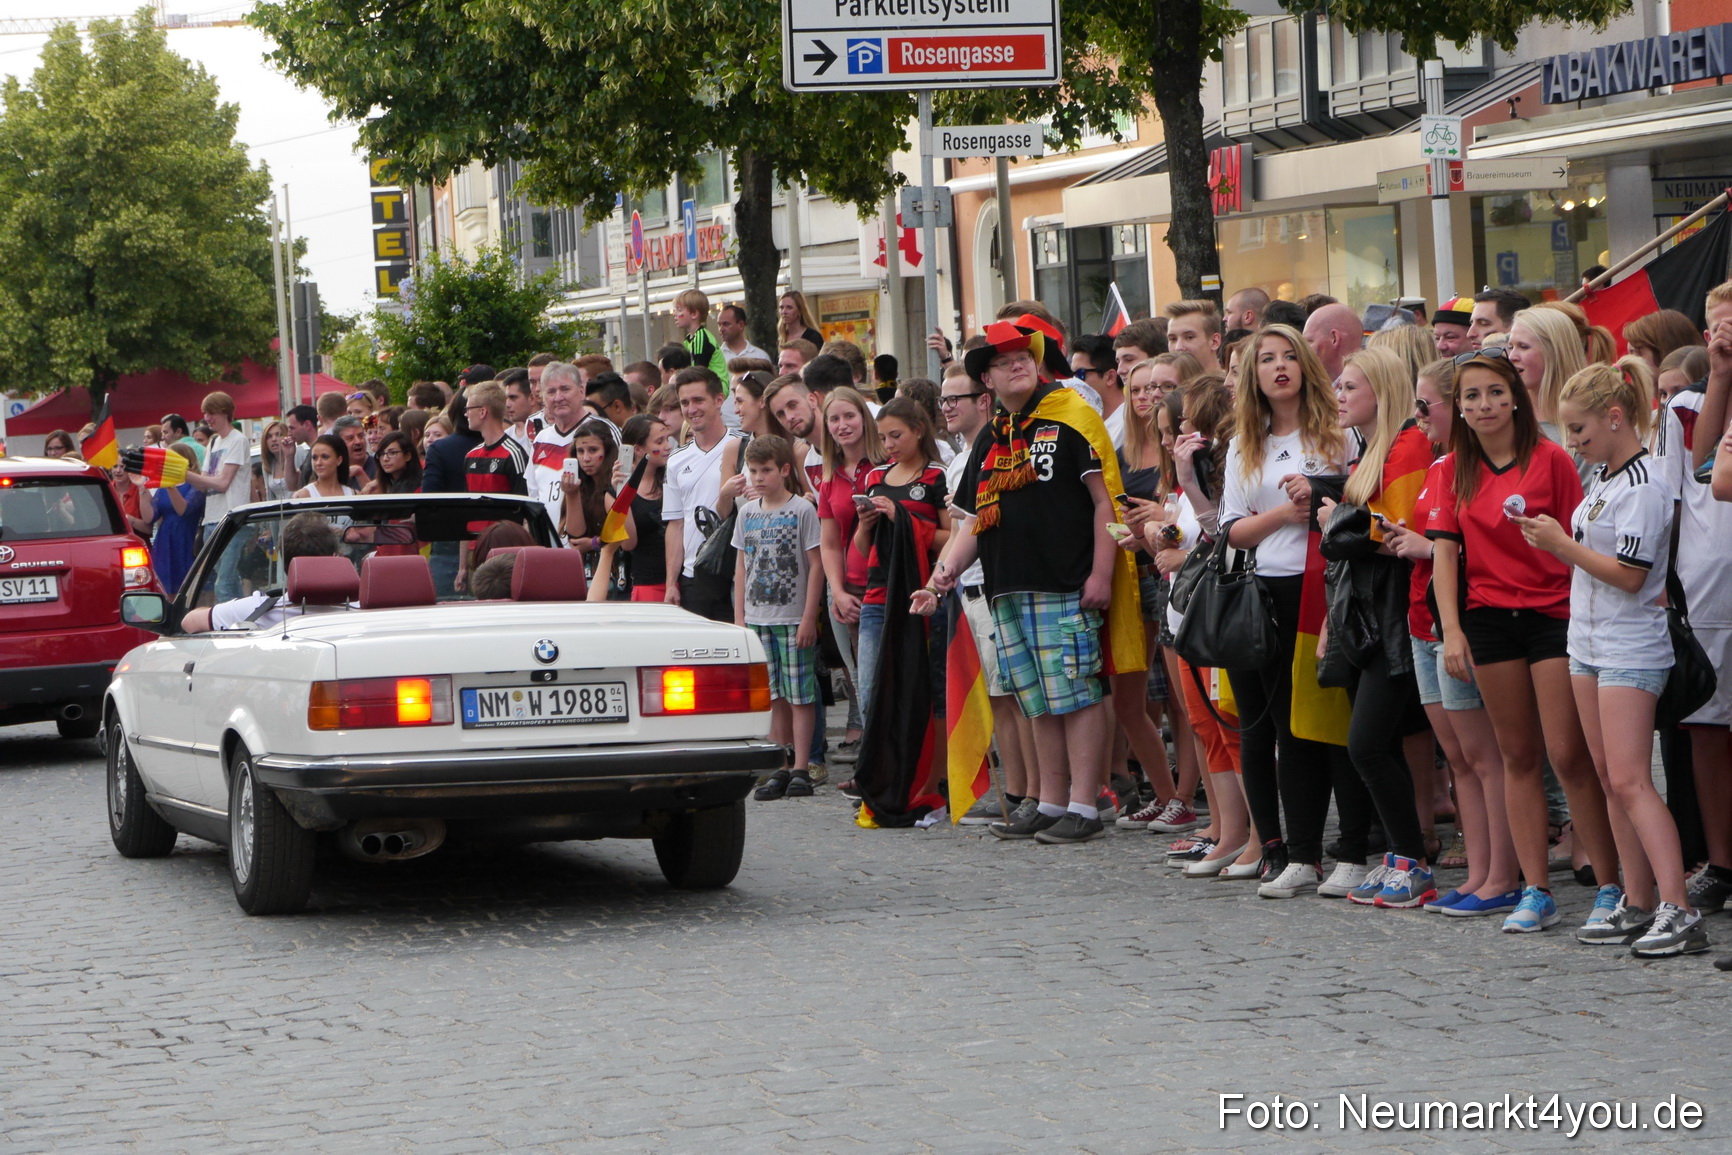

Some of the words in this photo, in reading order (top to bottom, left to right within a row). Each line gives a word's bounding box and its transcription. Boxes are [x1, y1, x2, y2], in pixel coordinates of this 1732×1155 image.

[836, 0, 1010, 21] Parkleitsystem
[901, 41, 1015, 70] Rosengasse
[1535, 23, 1727, 104] TABAKWAREN
[943, 132, 1032, 153] Rosengasse
[1466, 171, 1532, 180] Brauereimuseum
[370, 157, 405, 295] OTEL
[549, 480, 561, 502] 13
[11, 560, 64, 569] CRUISER
[2, 579, 24, 597] SV
[28, 578, 51, 596] 11
[611, 687, 622, 696] 04
[479, 691, 510, 719] NM
[528, 690, 542, 716] W
[548, 688, 608, 716] 1988
[612, 705, 623, 714] 10
